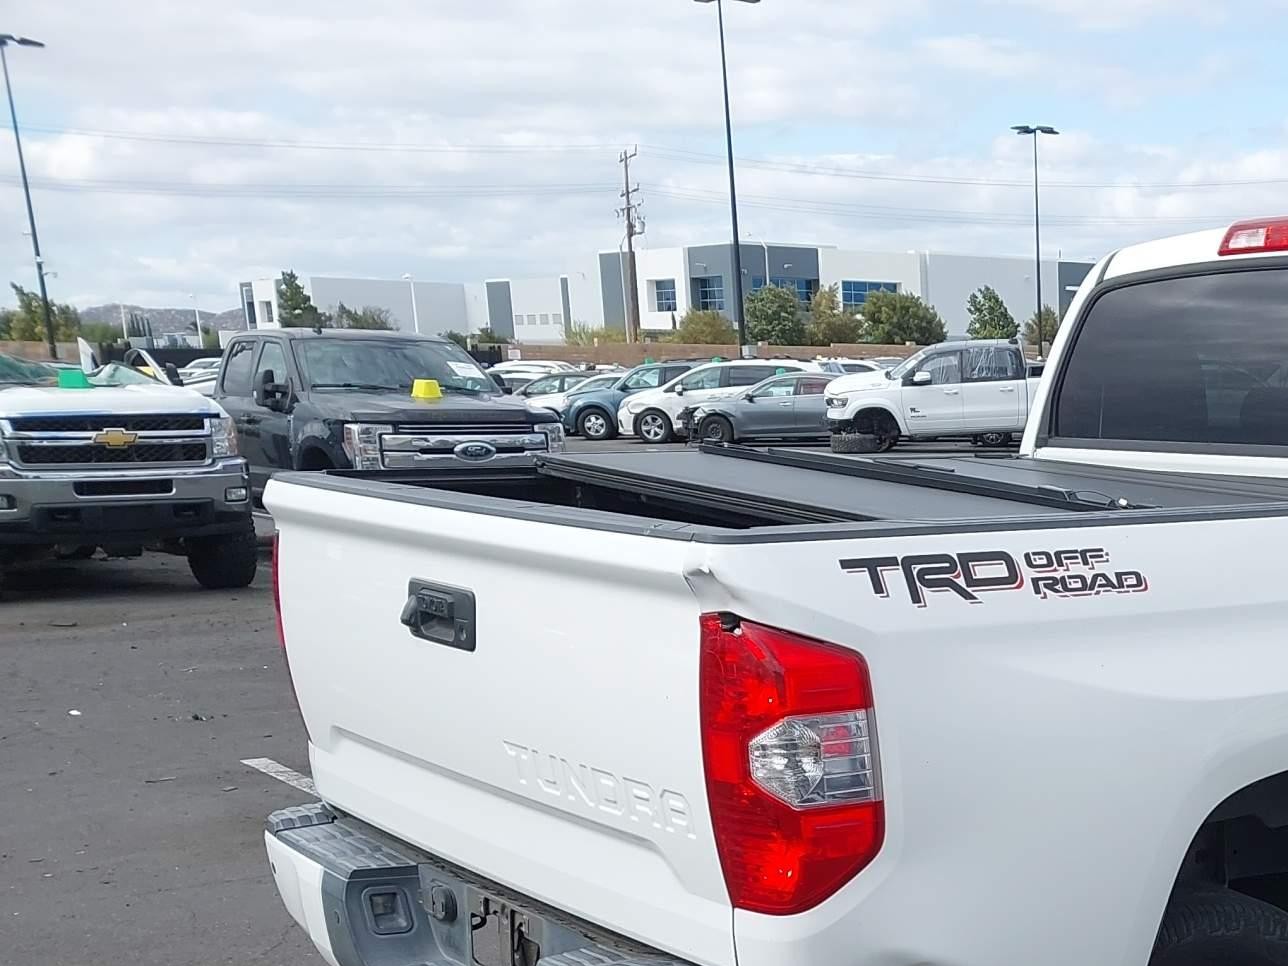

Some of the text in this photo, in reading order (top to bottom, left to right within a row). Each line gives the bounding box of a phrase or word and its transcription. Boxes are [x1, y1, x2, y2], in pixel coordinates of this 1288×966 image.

[838, 547, 1107, 607] TRD OFF
[1030, 570, 1148, 599] ROAD
[503, 740, 696, 839] TUNDRA
